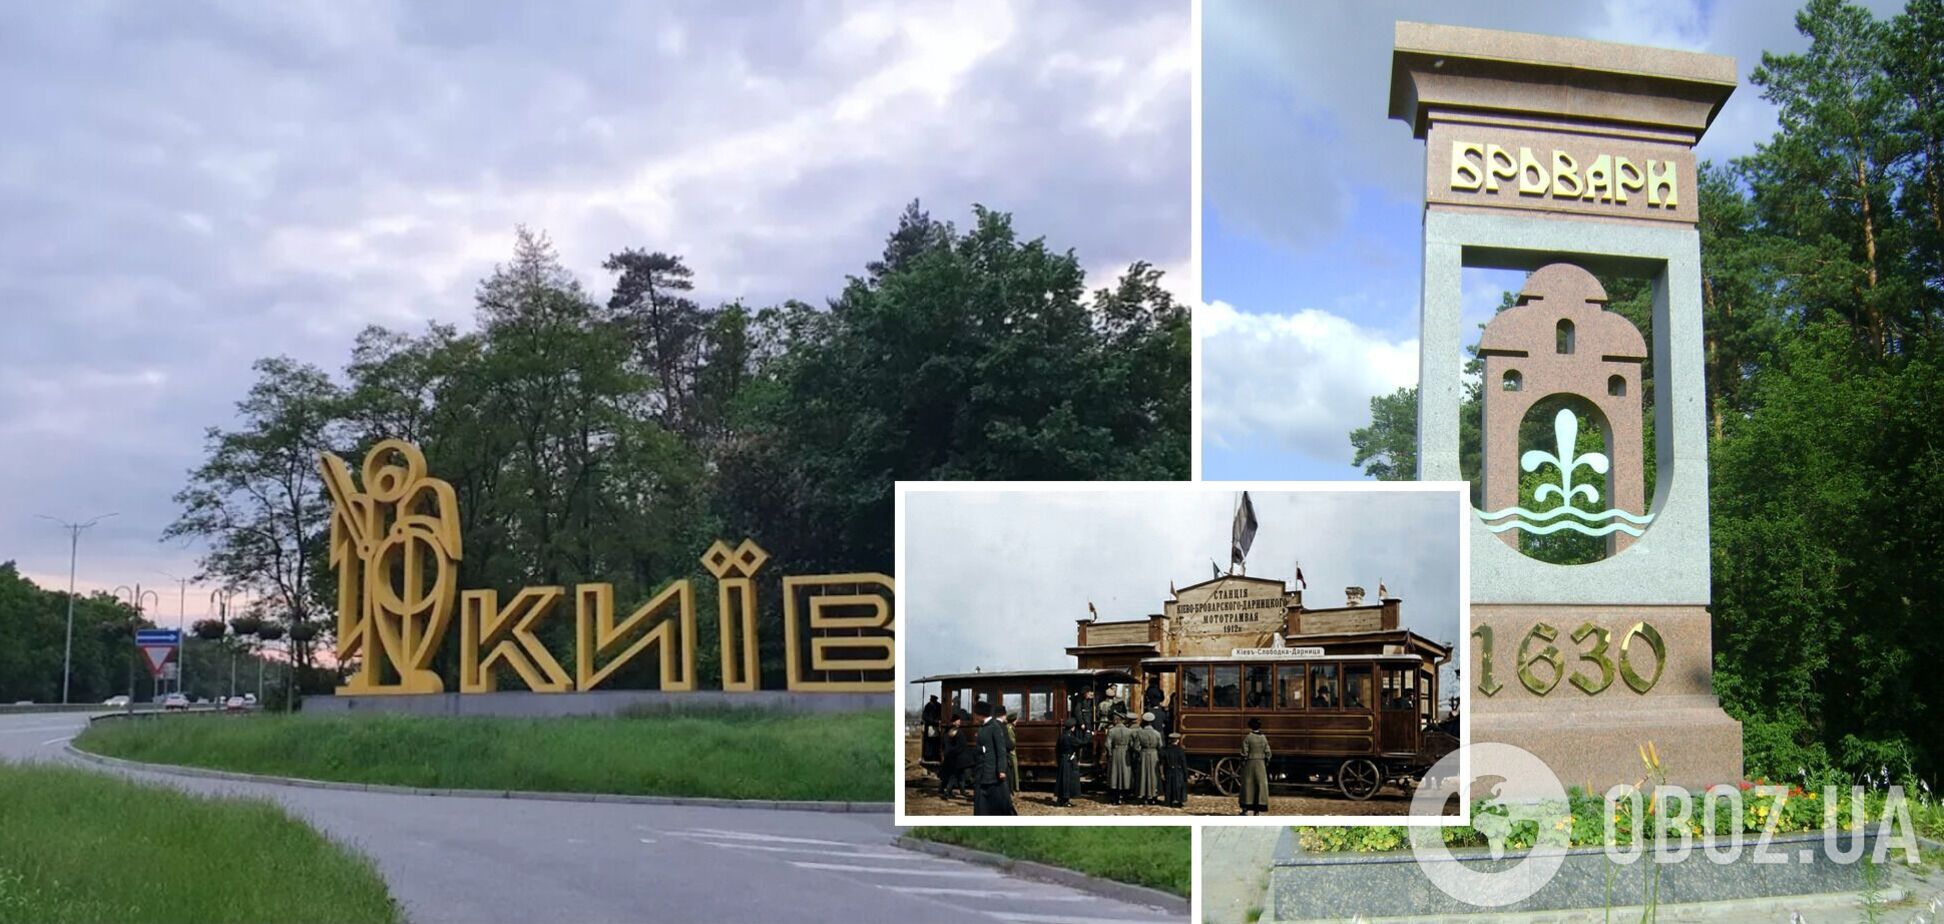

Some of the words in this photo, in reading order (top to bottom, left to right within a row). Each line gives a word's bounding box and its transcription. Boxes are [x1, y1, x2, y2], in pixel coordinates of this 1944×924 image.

[461, 537, 895, 693] КИЇВ
[1214, 588, 1248, 600] СТАНЦІЯ
[1203, 612, 1259, 624] МОТОТРАМВАЯ
[1471, 621, 1667, 696] 1630
